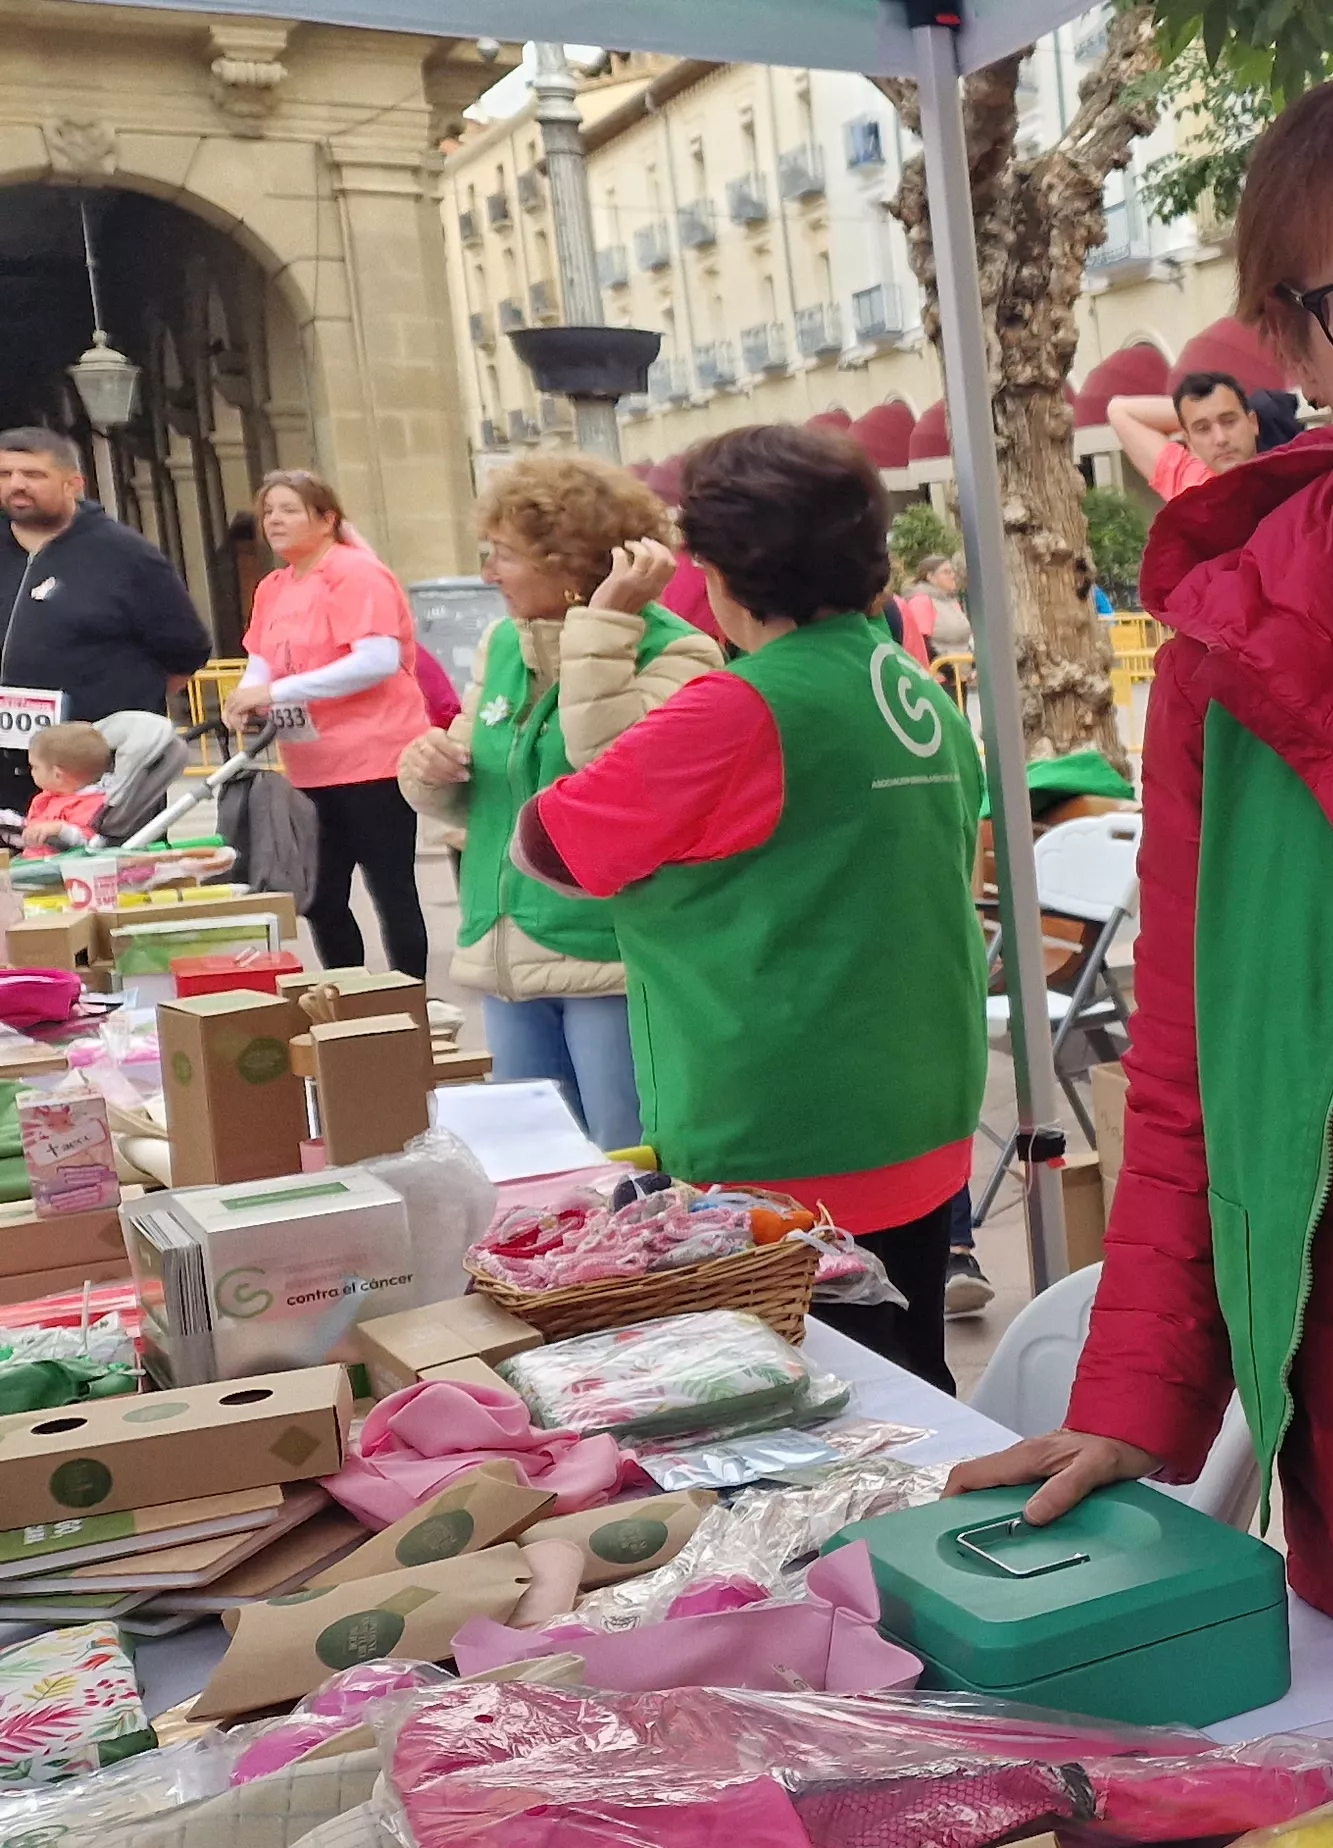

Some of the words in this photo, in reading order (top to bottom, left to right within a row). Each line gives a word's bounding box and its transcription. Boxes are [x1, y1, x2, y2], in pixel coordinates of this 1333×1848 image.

[286, 1289, 340, 1306] contra
[342, 1282, 356, 1296] el
[359, 1272, 414, 1292] cáncer
